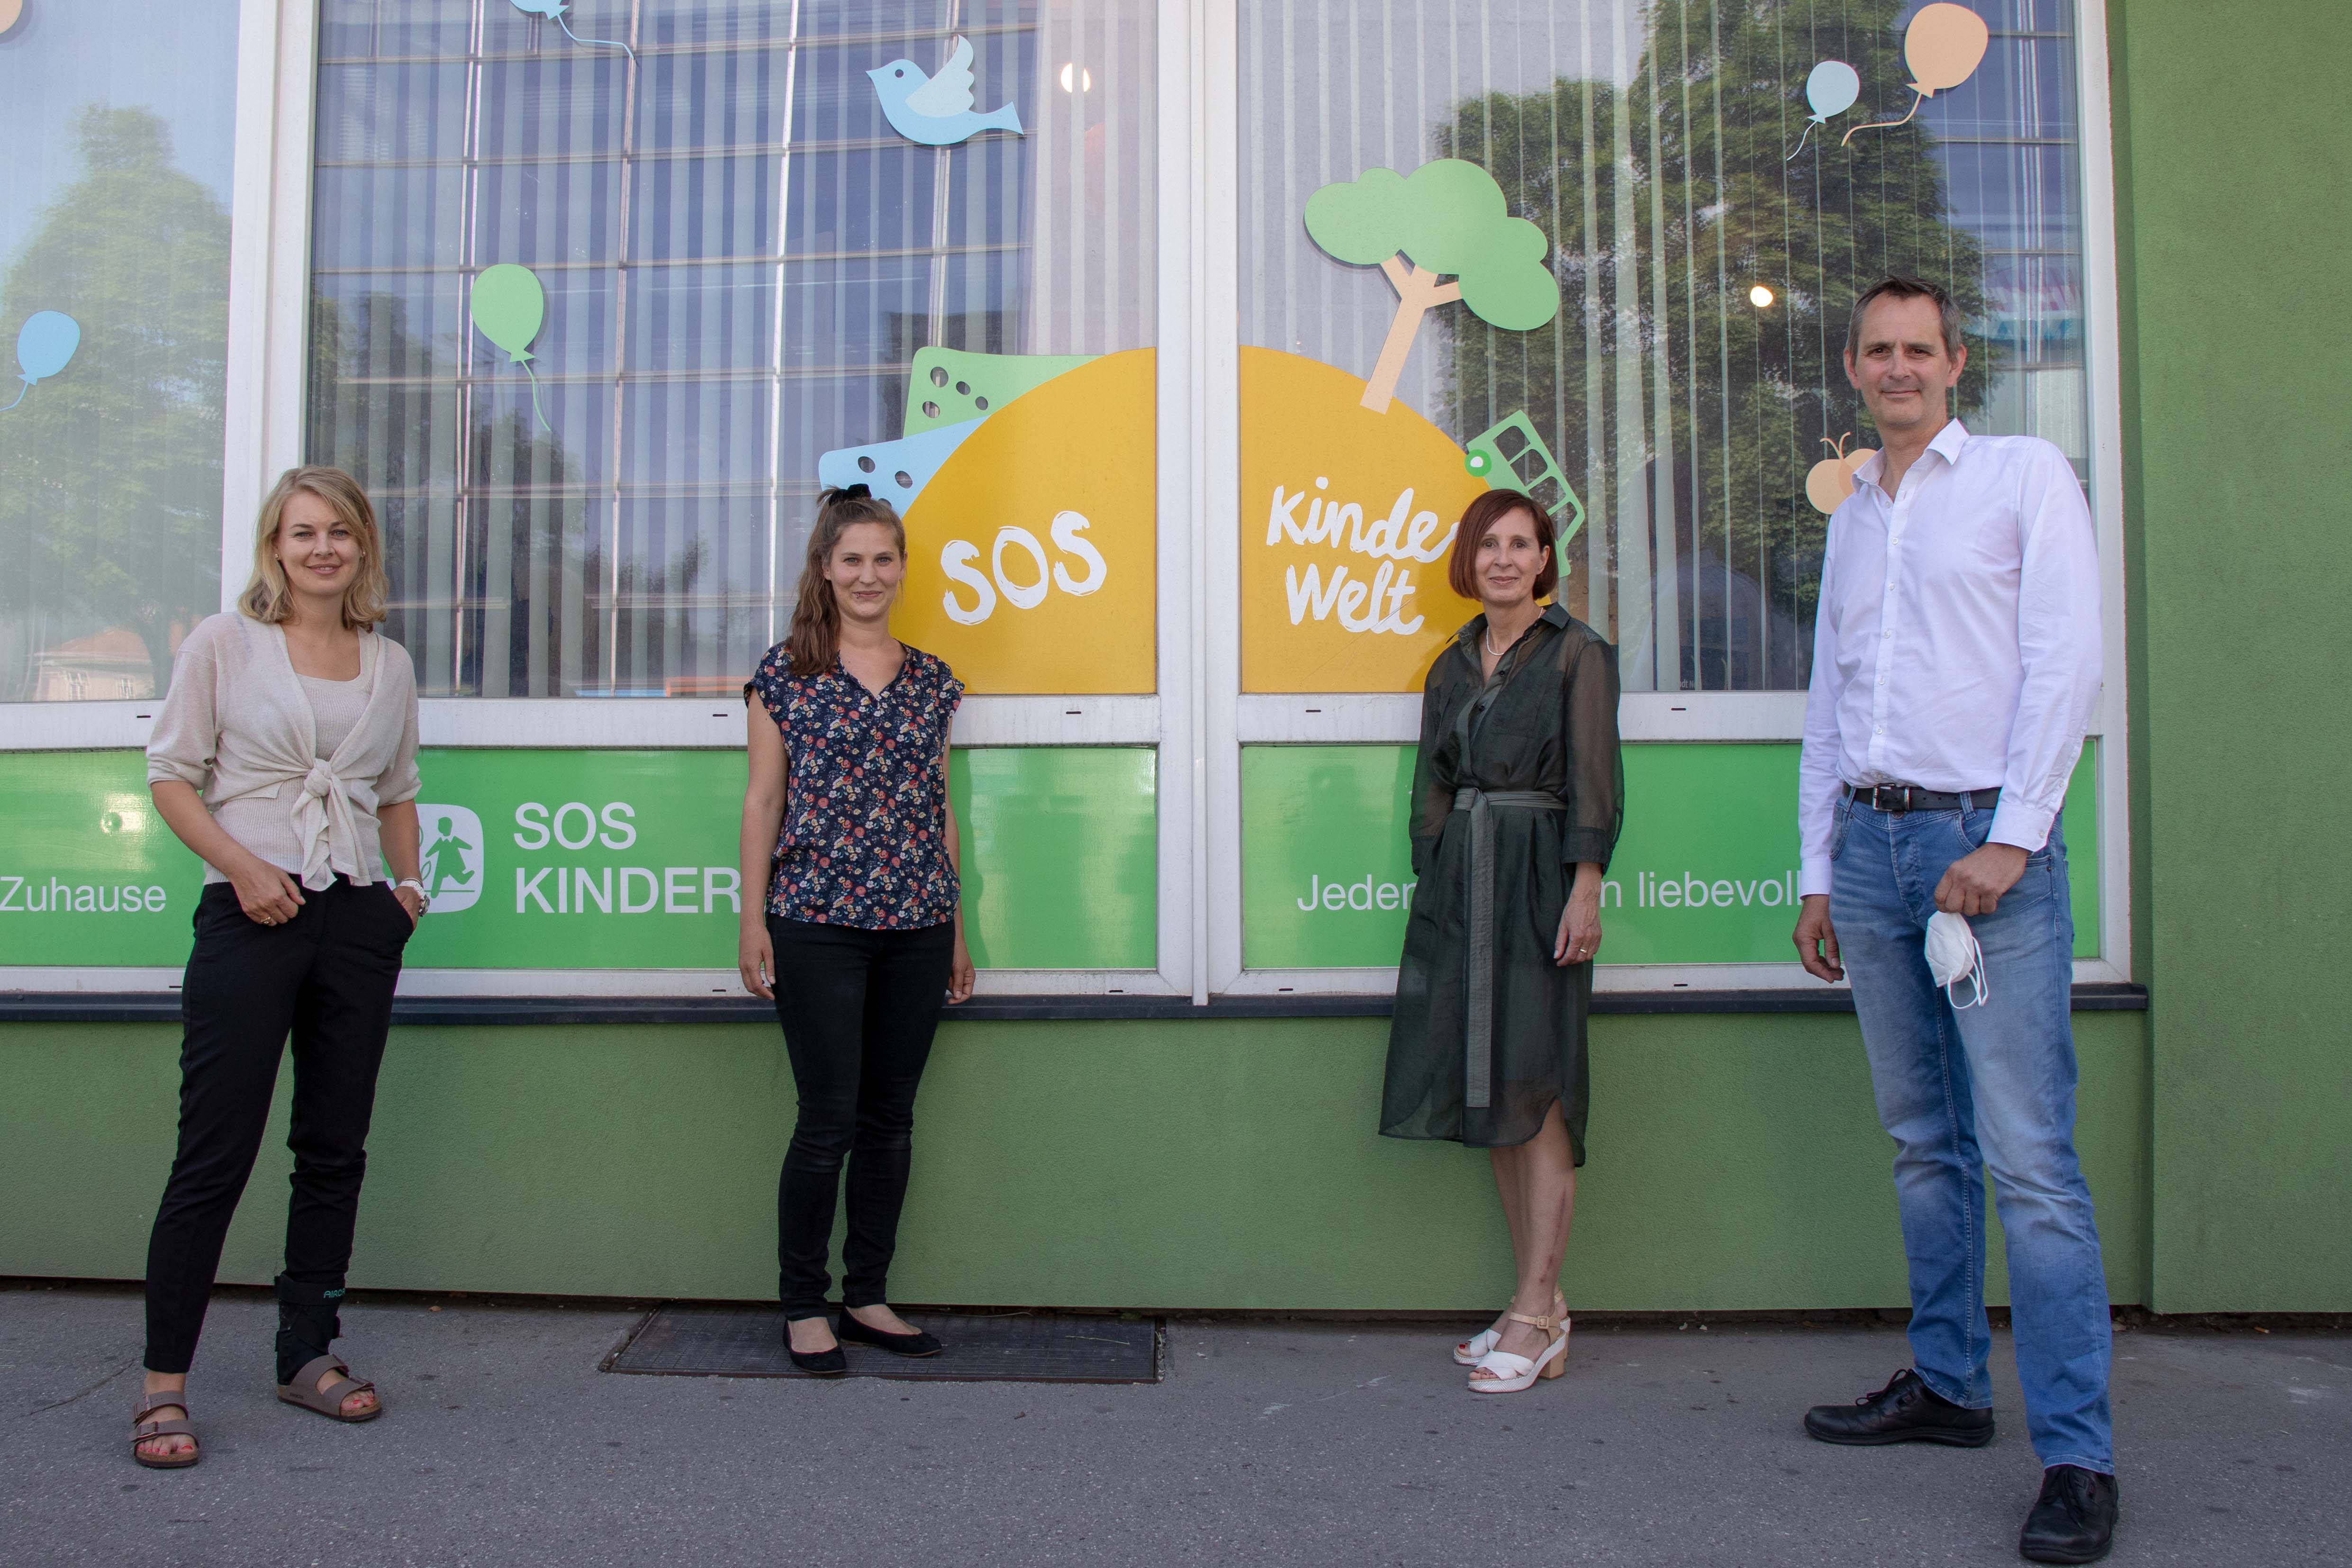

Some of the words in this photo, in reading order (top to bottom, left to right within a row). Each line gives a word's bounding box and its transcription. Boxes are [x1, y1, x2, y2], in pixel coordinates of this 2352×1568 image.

[1266, 477, 1460, 563] Kinde
[941, 510, 1107, 625] SOS
[1285, 561, 1425, 635] Welt
[514, 802, 636, 850] SOS
[0, 877, 166, 912] Zuhause
[516, 867, 742, 914] KINDER
